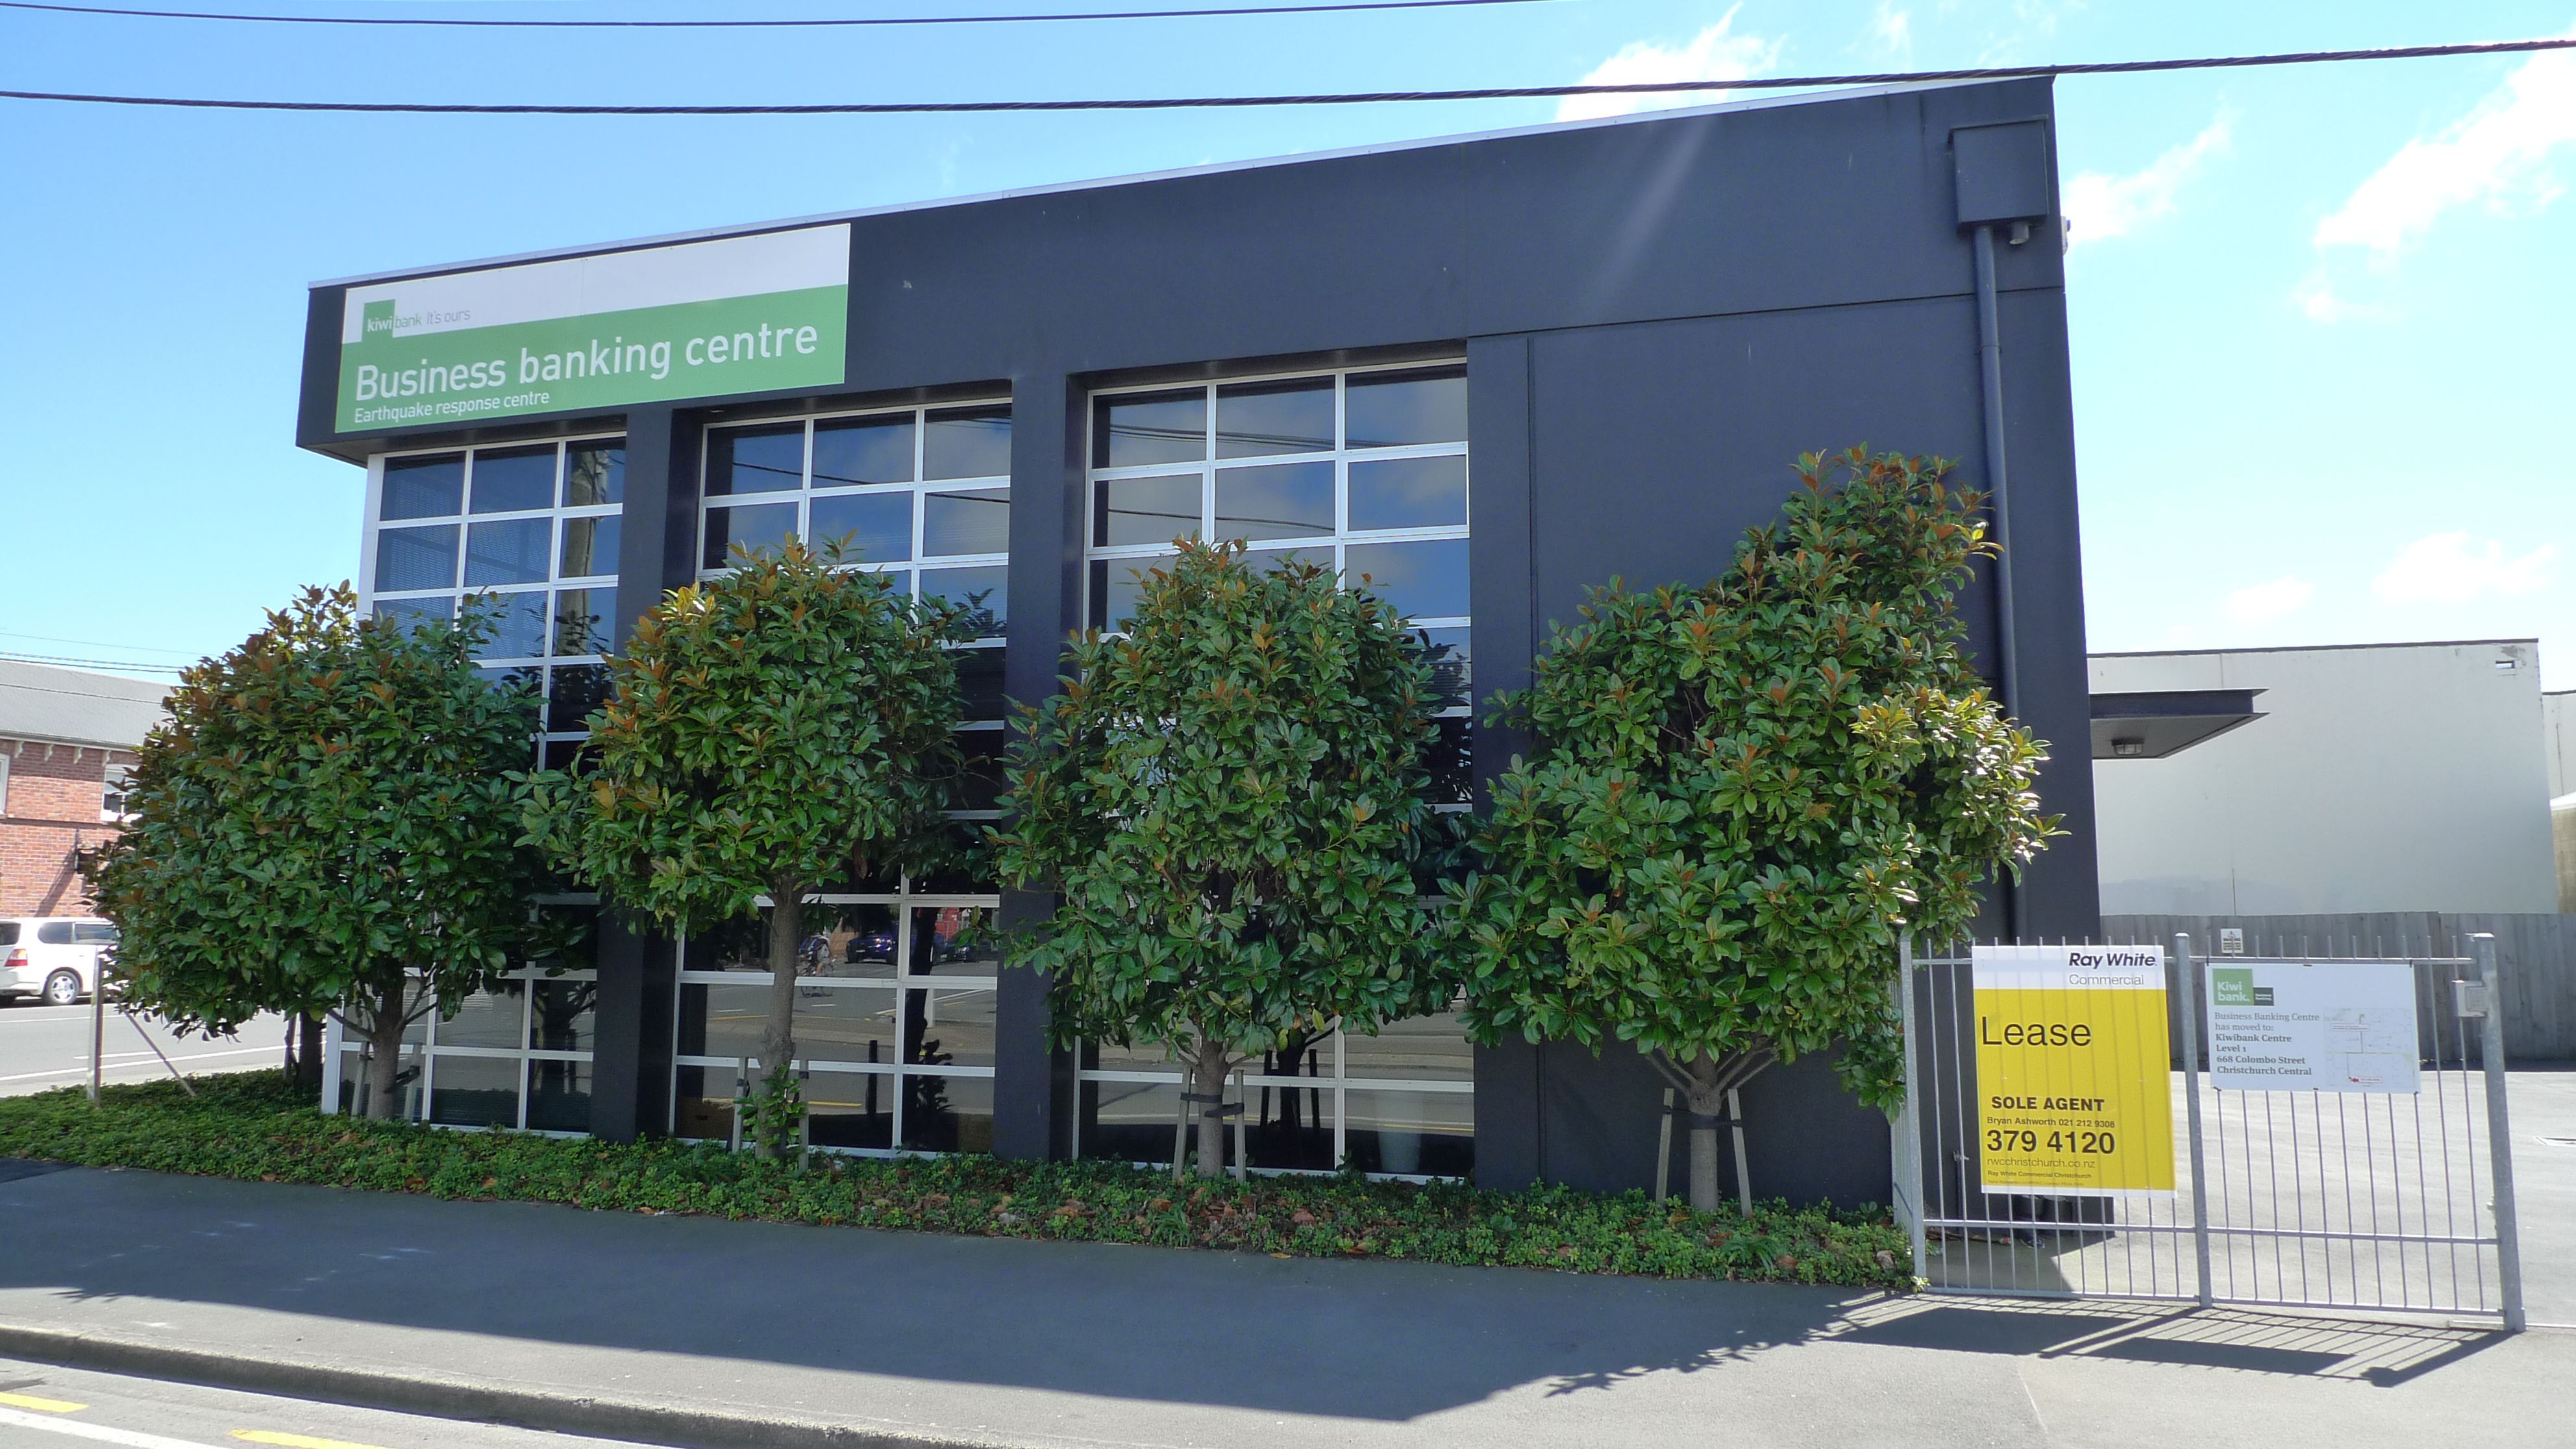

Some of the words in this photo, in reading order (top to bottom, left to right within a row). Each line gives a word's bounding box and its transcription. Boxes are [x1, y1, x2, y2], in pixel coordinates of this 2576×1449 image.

[444, 310, 471, 323] ours
[356, 358, 506, 401] Business
[519, 336, 671, 384] banking
[686, 323, 818, 366] centre
[354, 401, 433, 423] Earthquake
[435, 397, 501, 416] response
[503, 391, 550, 408] centre
[2068, 952, 2103, 969] Ray
[2106, 953, 2156, 967] White
[2068, 974, 2144, 985] Commercial
[2217, 981, 2242, 991] Kiwi
[2218, 991, 2250, 1002] bank.
[2214, 1011, 2253, 1021] Business
[2253, 1012, 2290, 1022] Banking
[2291, 1013, 2320, 1021] Centre
[1981, 1016, 2092, 1046] Lease
[2215, 1022, 2231, 1031] has
[2216, 1034, 2260, 1042] Kiwibank
[2216, 1044, 2240, 1052] Level
[2217, 1065, 2276, 1074] Christchurch
[2278, 1067, 2312, 1075] Central
[1991, 1096, 2038, 1109] SOLE
[2043, 1097, 2105, 1111] AGENT
[1987, 1116, 2012, 1126] Bryan
[2014, 1117, 2057, 1126] Ashworth
[2094, 1120, 2115, 1128] 9308
[1987, 1129, 2037, 1152] 379
[2046, 1131, 2115, 1154] 4120
